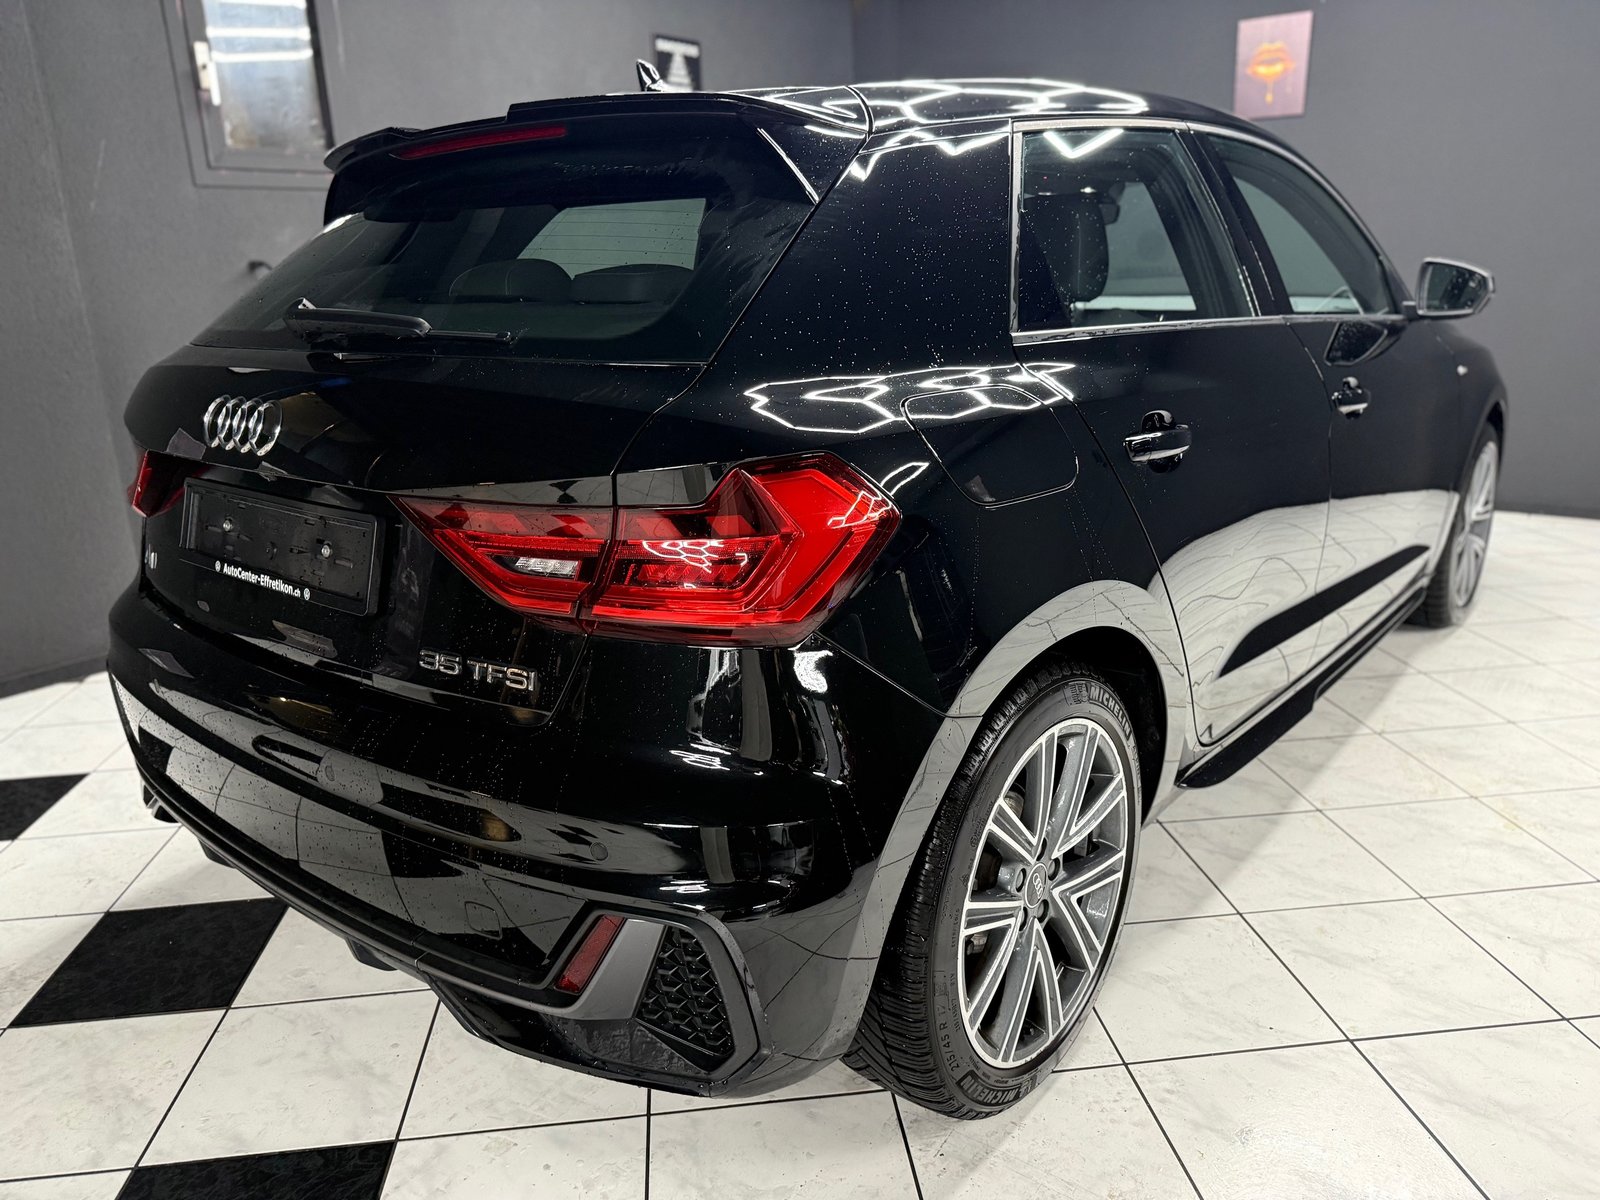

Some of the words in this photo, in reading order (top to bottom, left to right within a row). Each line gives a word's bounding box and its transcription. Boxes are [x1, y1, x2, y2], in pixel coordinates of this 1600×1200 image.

[223, 563, 300, 597] AutoCenter-Effretikon.ch
[420, 649, 461, 675] 35
[466, 660, 537, 691] TFSI
[1089, 685, 1132, 738] MICHELIN
[960, 1075, 1019, 1104] MICHELIN
